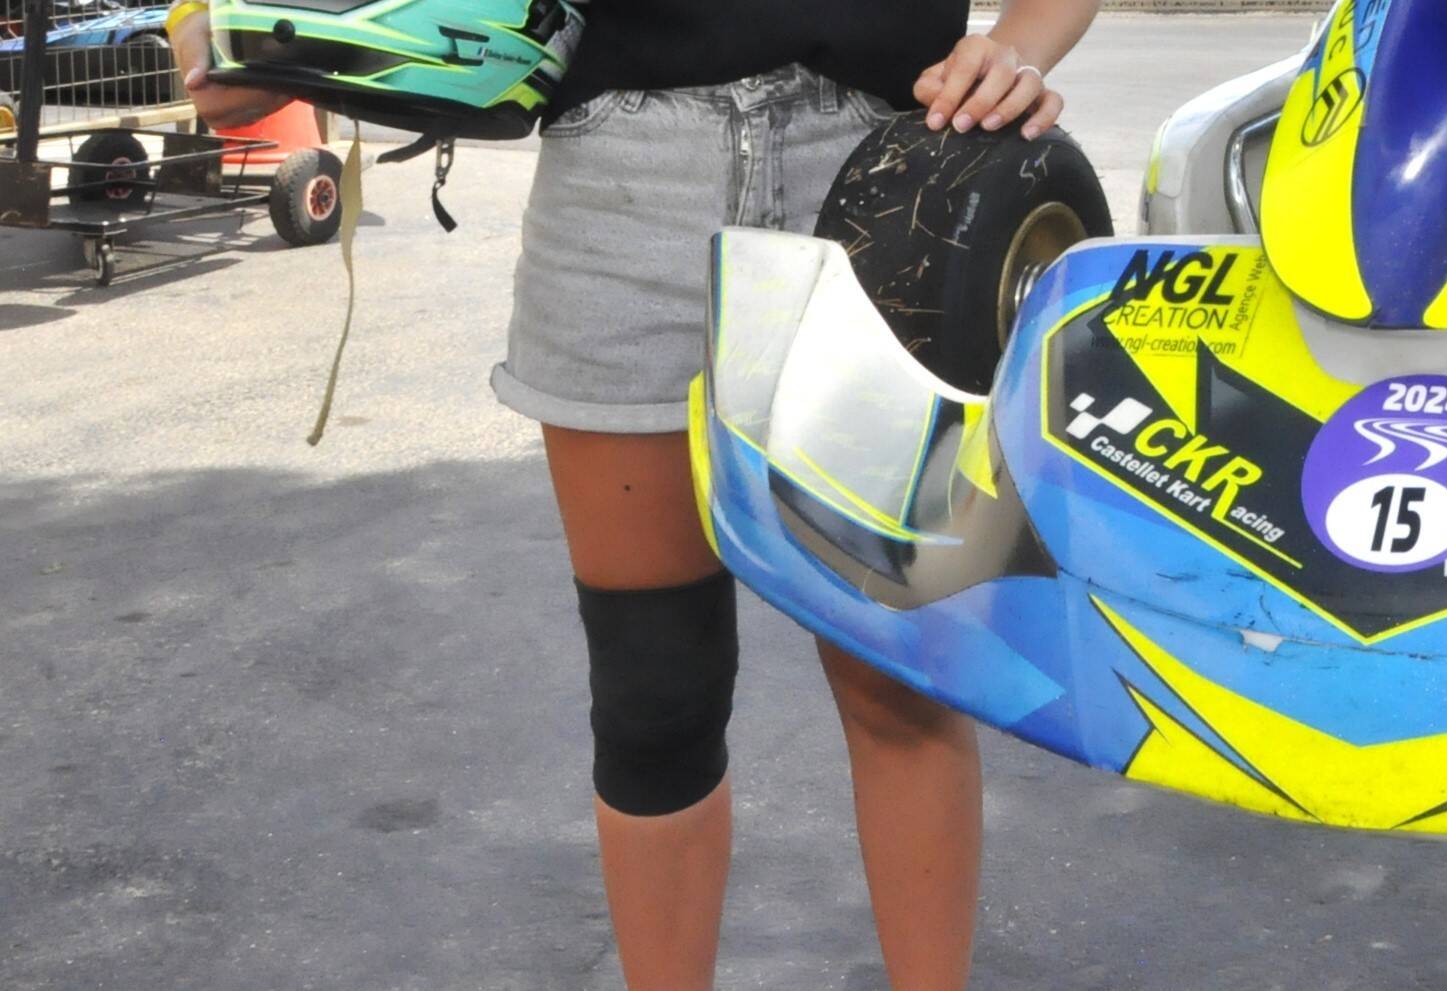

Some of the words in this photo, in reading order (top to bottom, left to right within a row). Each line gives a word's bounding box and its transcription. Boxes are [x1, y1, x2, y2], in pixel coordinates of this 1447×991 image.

[1109, 249, 1239, 305] NGL
[1230, 283, 1257, 331] Agence
[1091, 334, 1236, 355] www.ngl-creatiocom
[1090, 435, 1169, 488] Castellet
[1166, 473, 1211, 512] Kart
[1231, 502, 1285, 543] acing
[1133, 418, 1263, 522] CKR
[1370, 485, 1426, 554] 15
